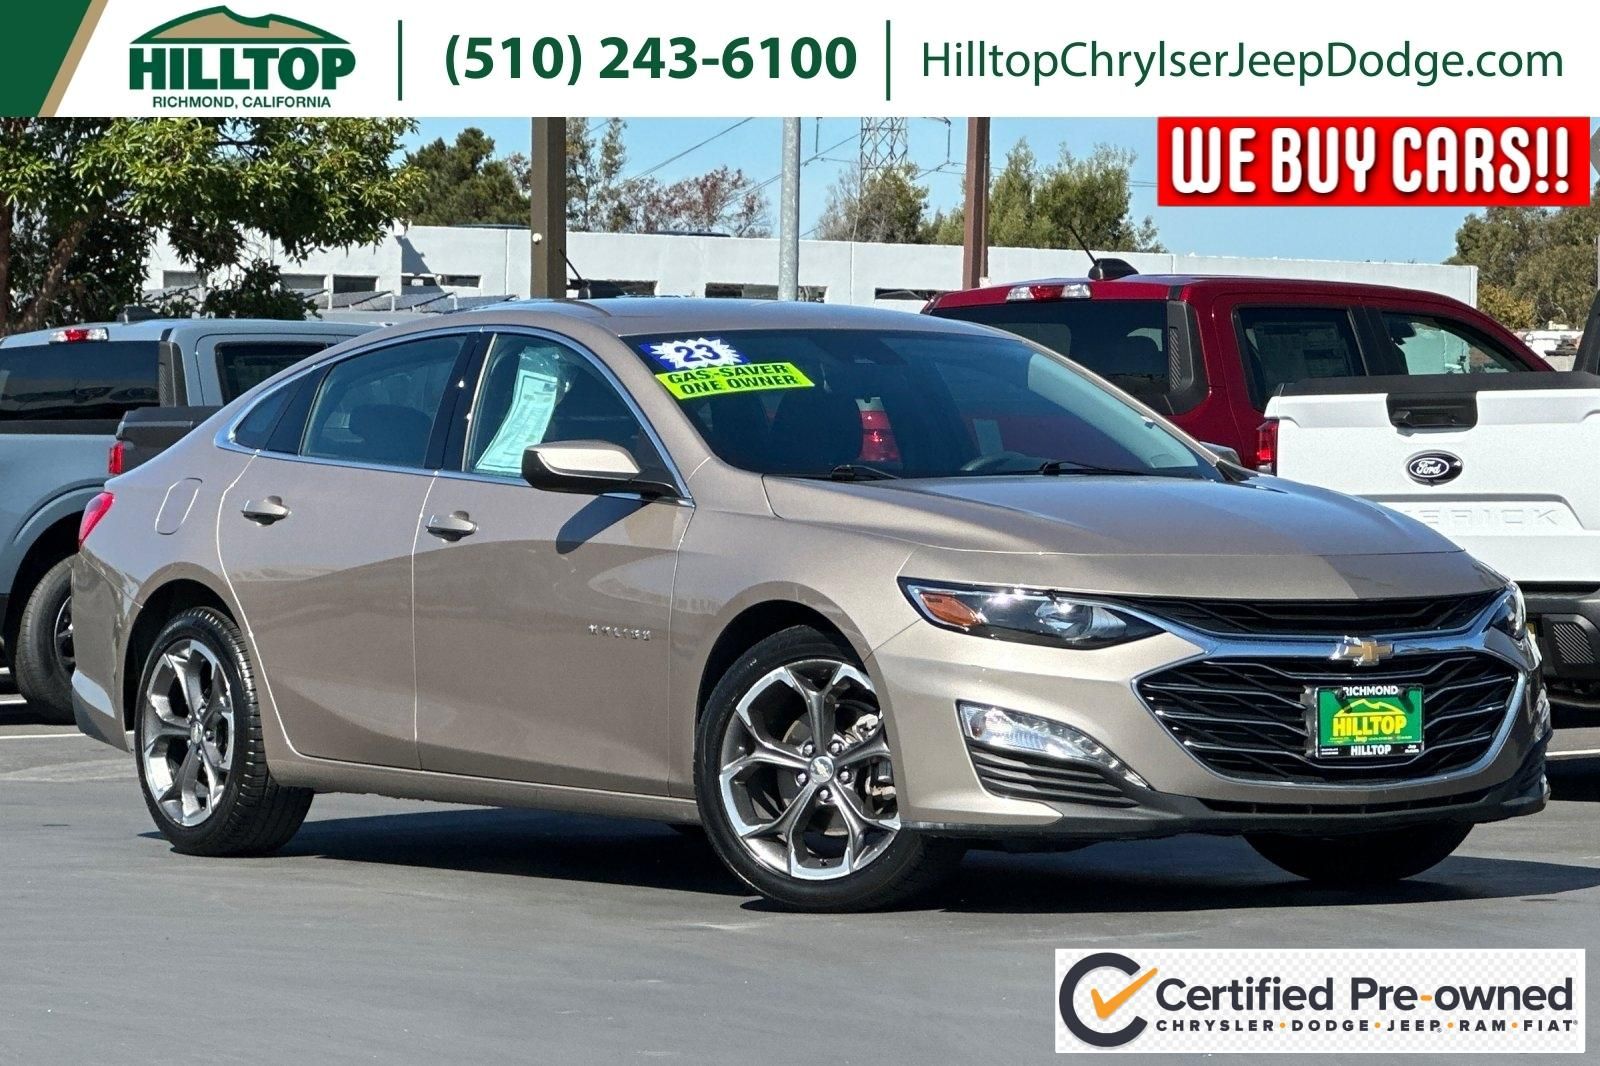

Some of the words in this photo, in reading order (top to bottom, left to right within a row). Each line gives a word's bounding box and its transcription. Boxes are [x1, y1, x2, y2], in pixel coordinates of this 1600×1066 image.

[674, 344, 722, 362] 23
[680, 380, 721, 395] ONE
[726, 375, 799, 389] OWNER
[1416, 460, 1442, 475] Ford
[1343, 685, 1399, 697] RICHMOND
[1333, 715, 1407, 737] HILLTOP
[1350, 744, 1392, 756] HILLTOP
